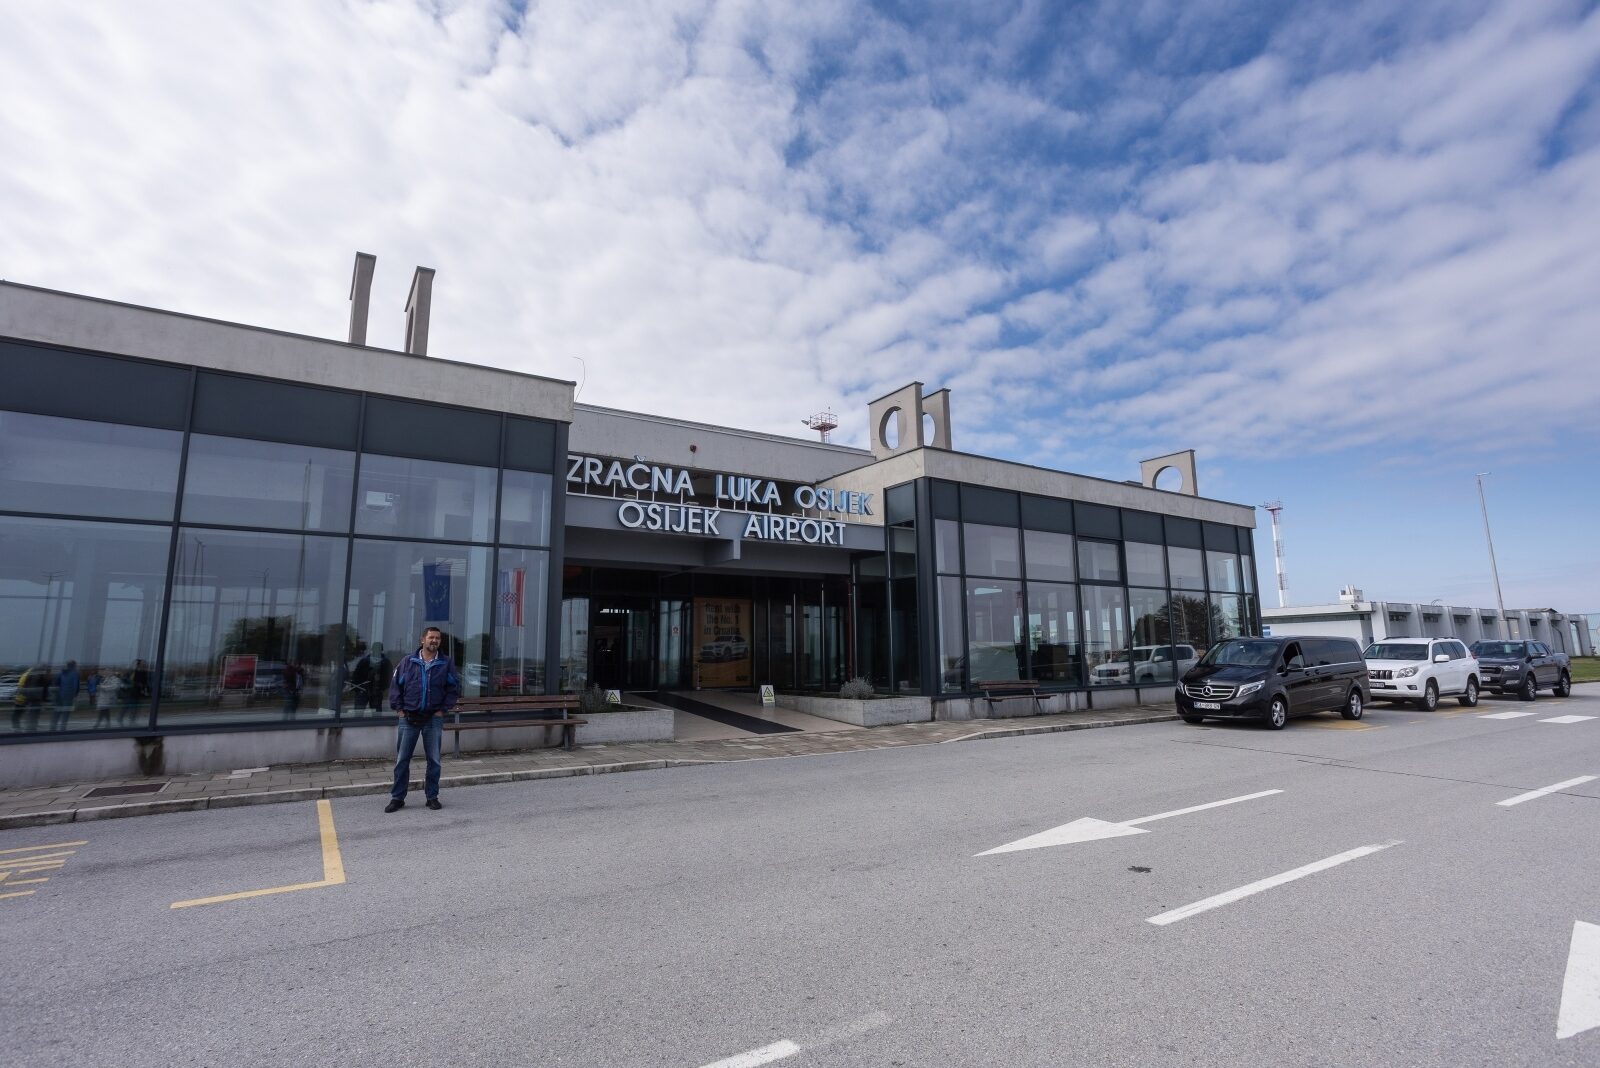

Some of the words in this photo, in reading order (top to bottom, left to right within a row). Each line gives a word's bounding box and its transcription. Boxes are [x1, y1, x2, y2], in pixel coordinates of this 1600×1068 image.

[566, 455, 694, 496] ZRAČNA
[716, 474, 781, 506] LUKA
[795, 485, 874, 515] OSIJEK
[618, 501, 720, 535] OSIJEK
[743, 515, 846, 545] AIRPORT
